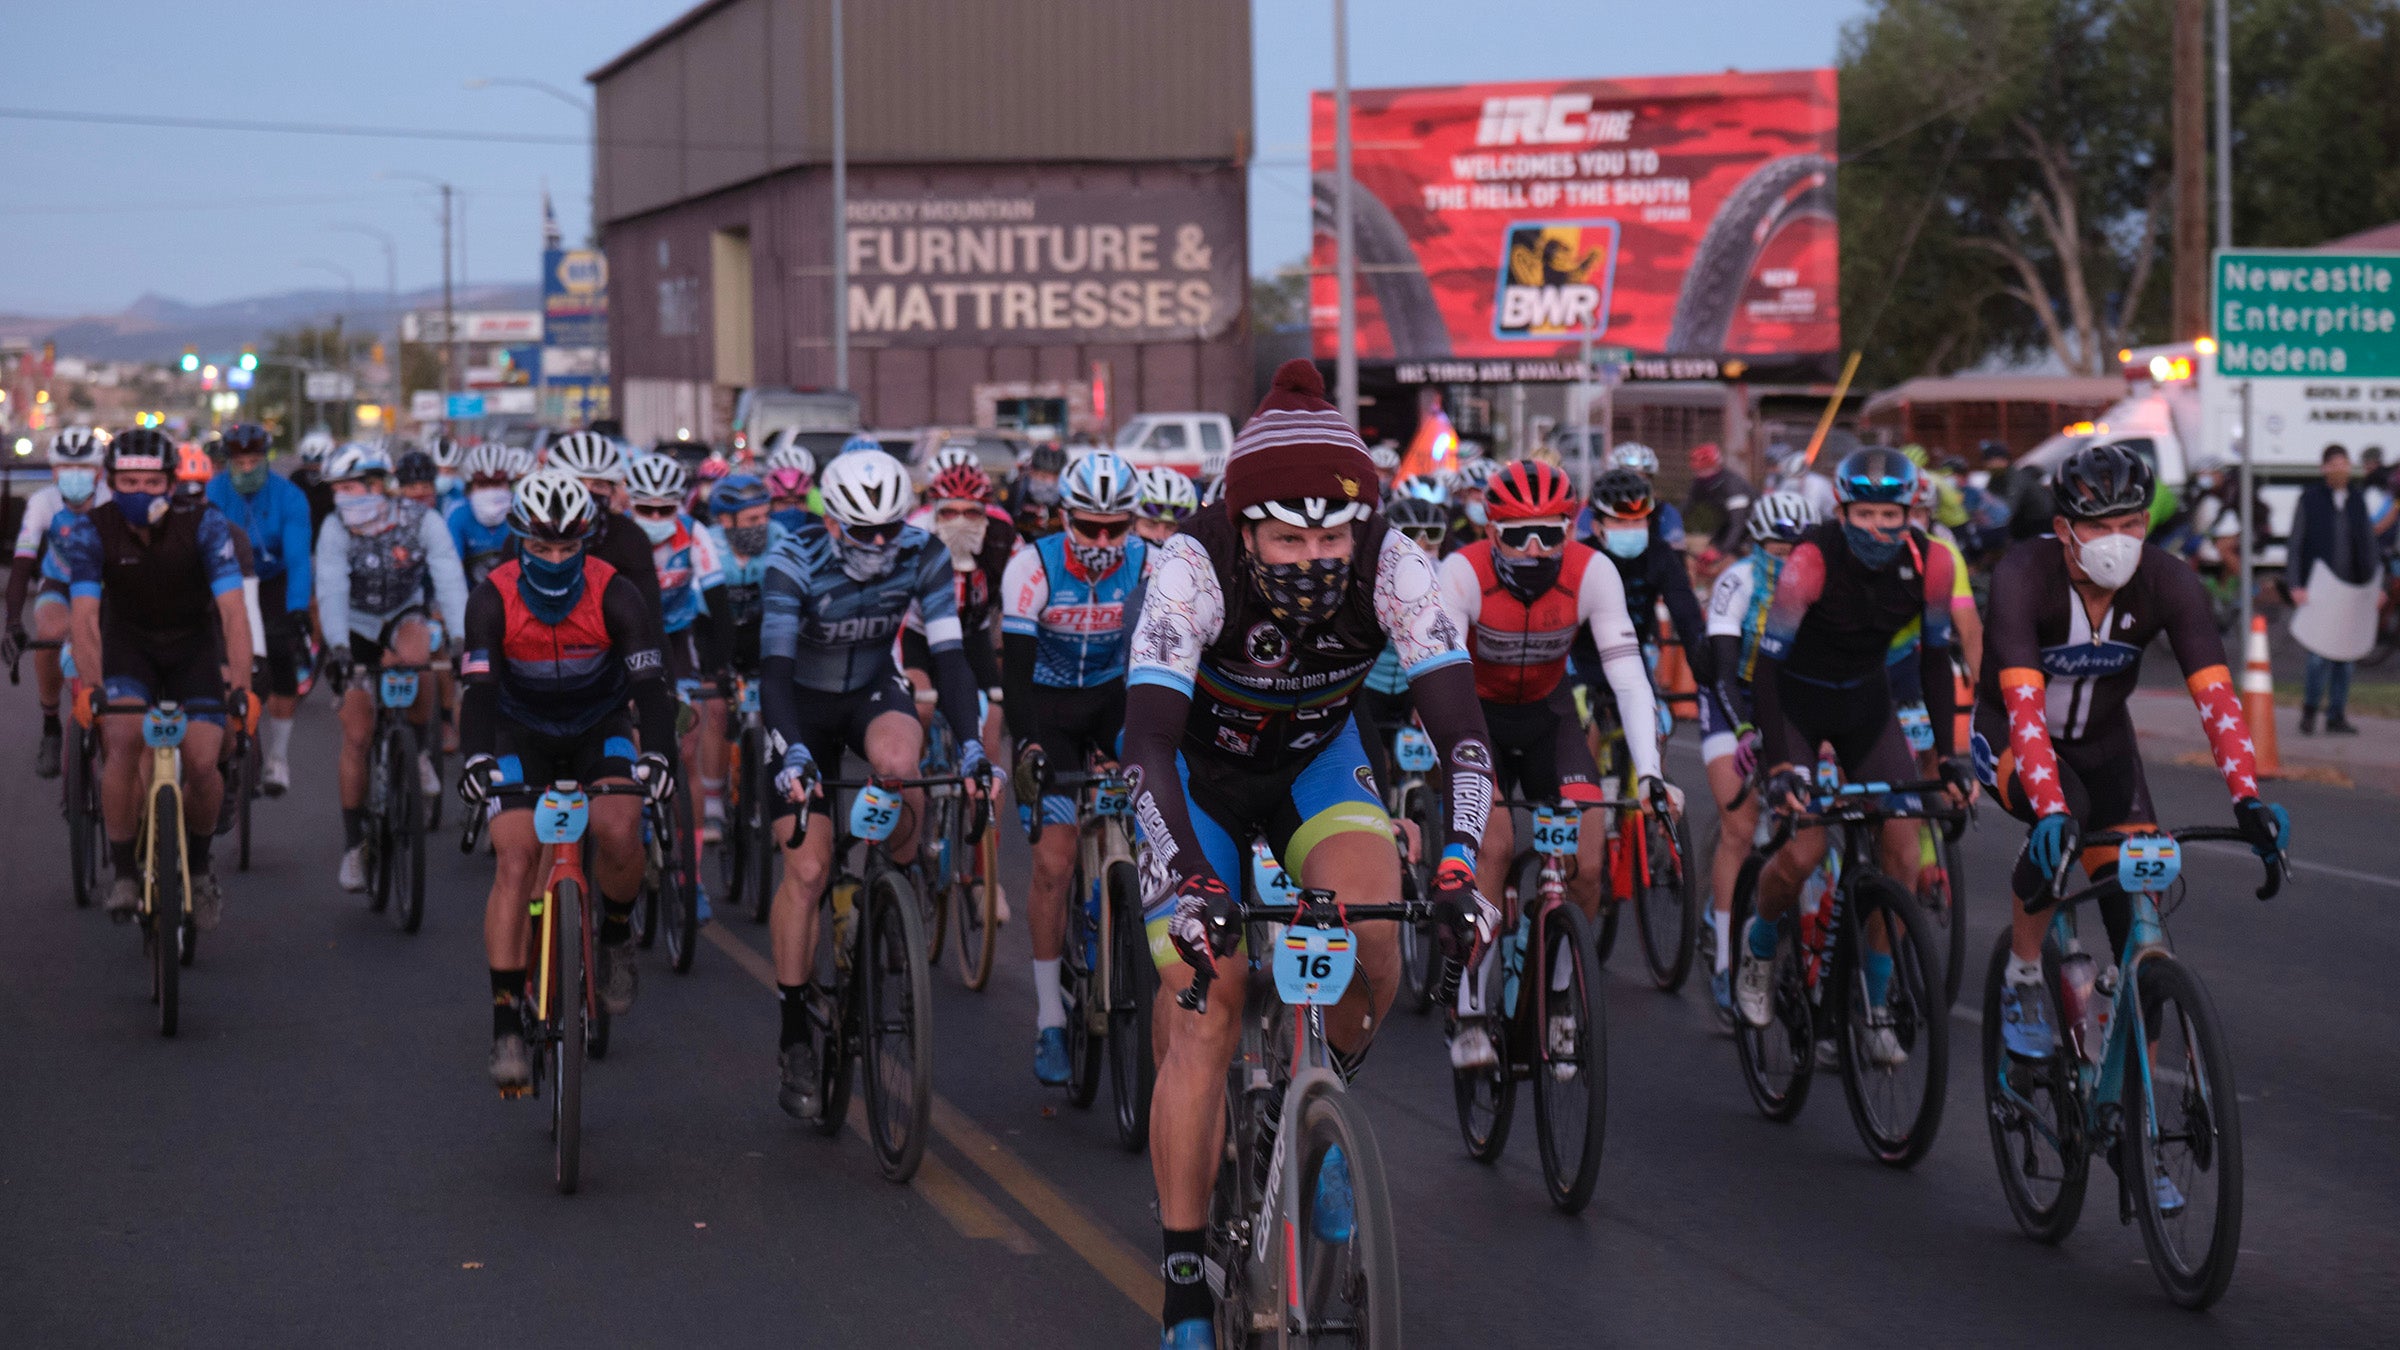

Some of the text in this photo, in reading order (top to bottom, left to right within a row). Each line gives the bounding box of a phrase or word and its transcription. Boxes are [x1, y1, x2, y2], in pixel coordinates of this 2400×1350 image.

[1583, 111, 1635, 142] TIRE
[1453, 148, 1660, 180] WELCOMES YOU TO
[1424, 178, 1690, 210] THE HELL OF THE SOUTH
[848, 201, 1034, 221] ROCKY MOUNTAIN
[848, 224, 1213, 275] FURNITURE &
[2224, 263, 2392, 293] Newcastle
[849, 279, 1213, 331] MATTRESSES
[1502, 285, 1600, 329] BWR
[2224, 302, 2396, 337] Enterprise
[1429, 364, 1476, 382] TIRES
[1479, 363, 1513, 382] ARE
[1634, 360, 1665, 378] THE
[1669, 359, 1718, 378] EXPO
[2224, 343, 2347, 373] Modena
[554, 812, 570, 828] 2
[863, 807, 893, 825] 25
[1534, 827, 1578, 845] 464
[2133, 861, 2166, 878] 52
[1296, 955, 1332, 978] 16
